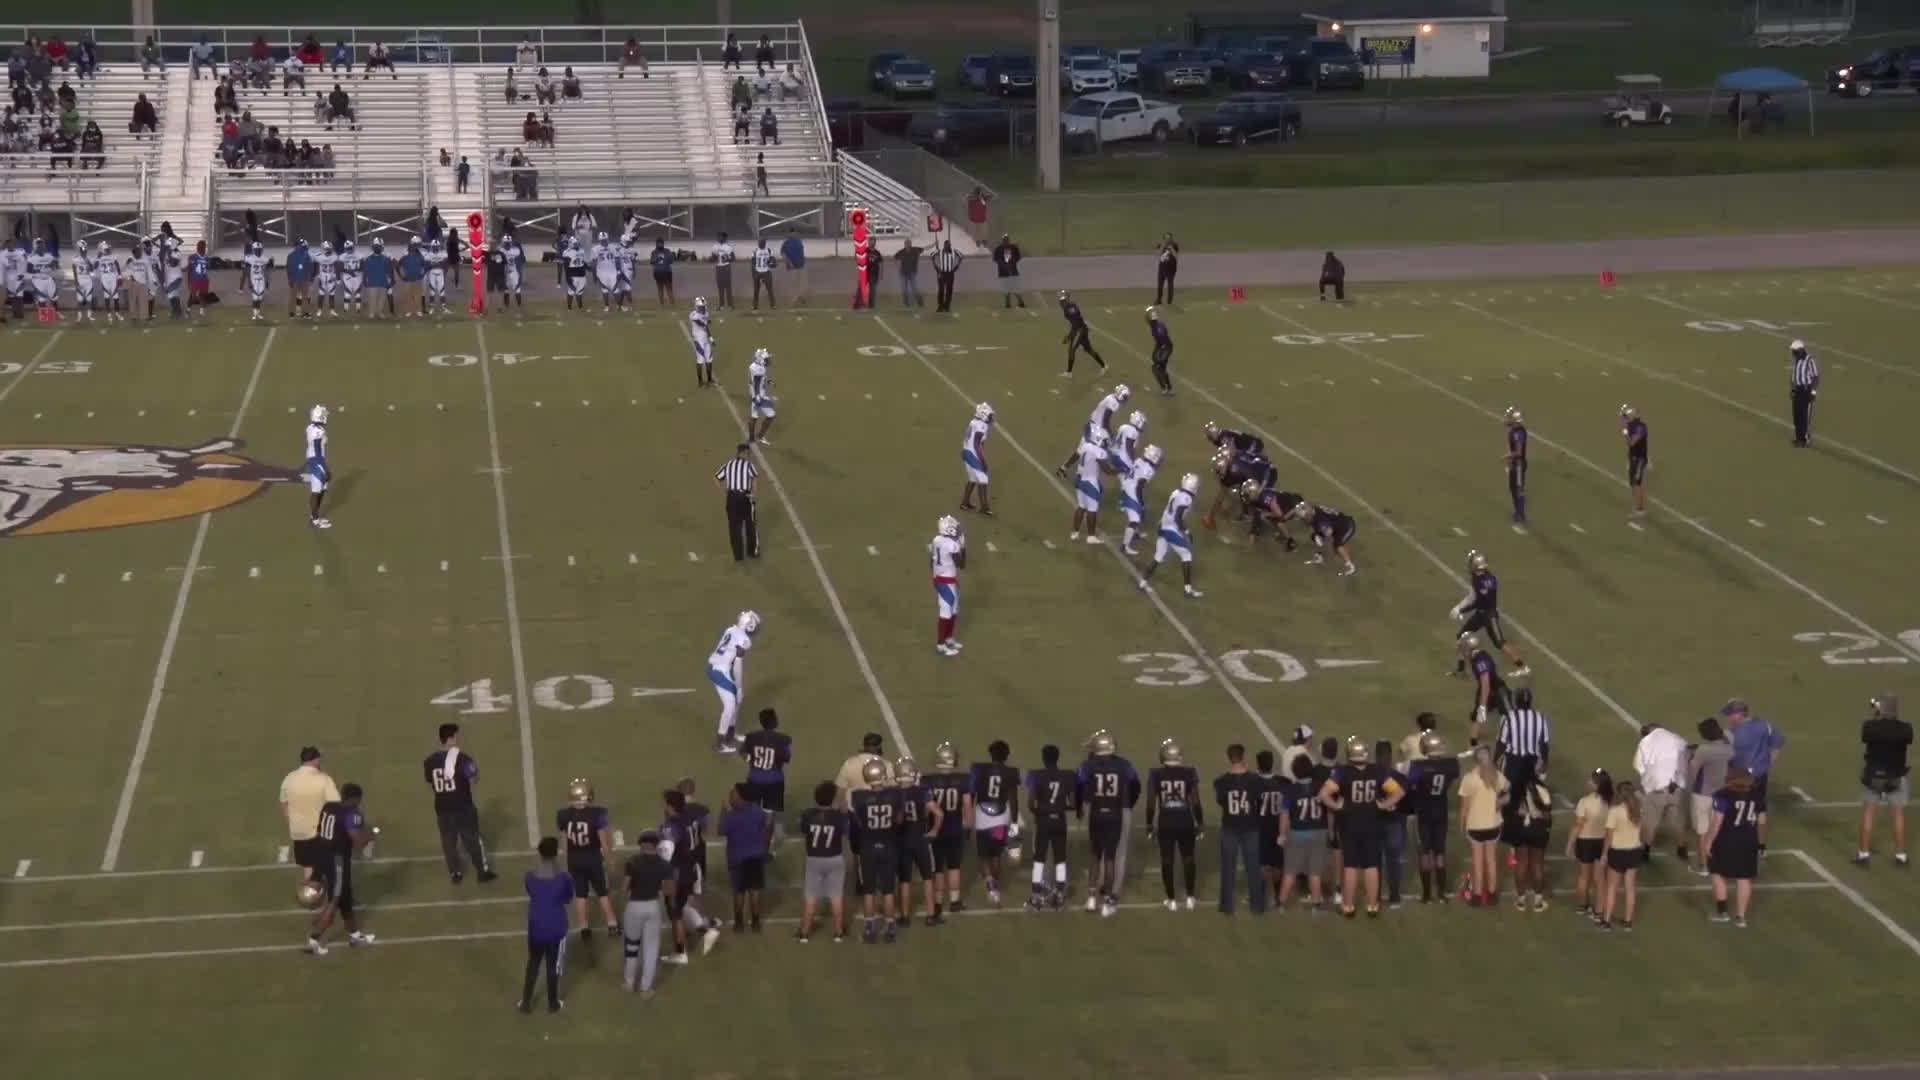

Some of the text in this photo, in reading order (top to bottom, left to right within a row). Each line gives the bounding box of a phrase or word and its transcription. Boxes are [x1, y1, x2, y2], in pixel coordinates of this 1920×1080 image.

[1117, 649, 1308, 686] 30
[430, 675, 614, 715] 40
[753, 746, 775, 770] 50
[987, 775, 1002, 798] 6
[1048, 782, 1060, 804] 7
[1095, 773, 1118, 797] 13
[1351, 780, 1376, 804] 66
[1430, 774, 1446, 796] 9
[933, 788, 958, 812] 70
[1227, 790, 1250, 815] 64
[320, 811, 336, 840] 10
[867, 804, 893, 830] 52
[1734, 800, 1757, 827] 74
[567, 820, 591, 846] 42
[809, 824, 836, 849] 77
